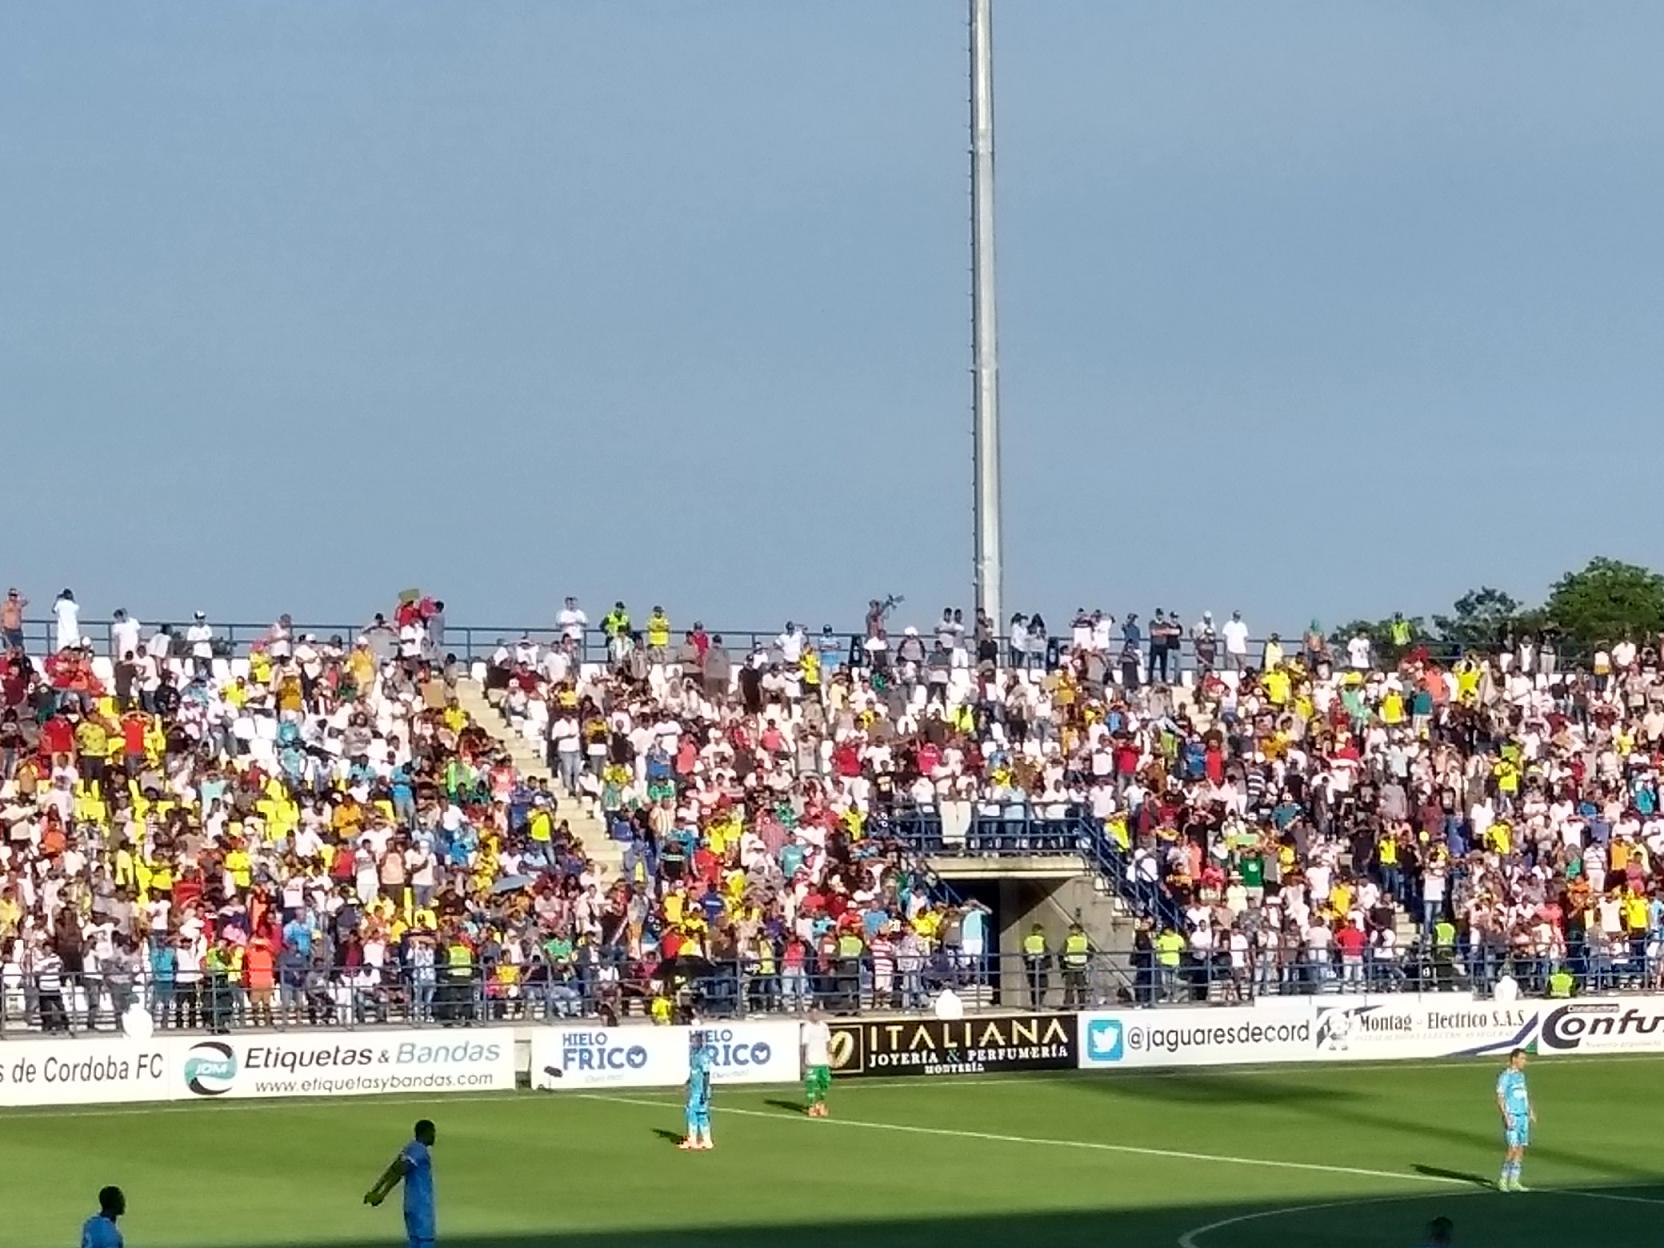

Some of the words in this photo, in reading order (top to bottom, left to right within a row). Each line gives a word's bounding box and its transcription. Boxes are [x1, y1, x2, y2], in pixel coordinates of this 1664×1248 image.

[1359, 1012, 1413, 1032] Montag
[1427, 1010, 1487, 1029] Electrico
[562, 1032, 608, 1046] HIELO
[869, 1017, 1069, 1051] ITALIANA
[1127, 1019, 1310, 1052] @jaguaresdecord
[12, 1057, 36, 1083] de
[44, 1055, 130, 1082] Cordoba
[136, 1053, 163, 1079] FC
[244, 1044, 373, 1073] Etiquetas
[377, 1050, 390, 1064] &
[396, 1040, 501, 1064] Bandas
[562, 1045, 648, 1070] FRICO
[868, 1051, 938, 1068] JOYERÍA
[946, 1049, 961, 1065] &
[967, 1044, 1069, 1062] PERFUMERÍA
[255, 1073, 493, 1093] www.etiquetasybandas.com
